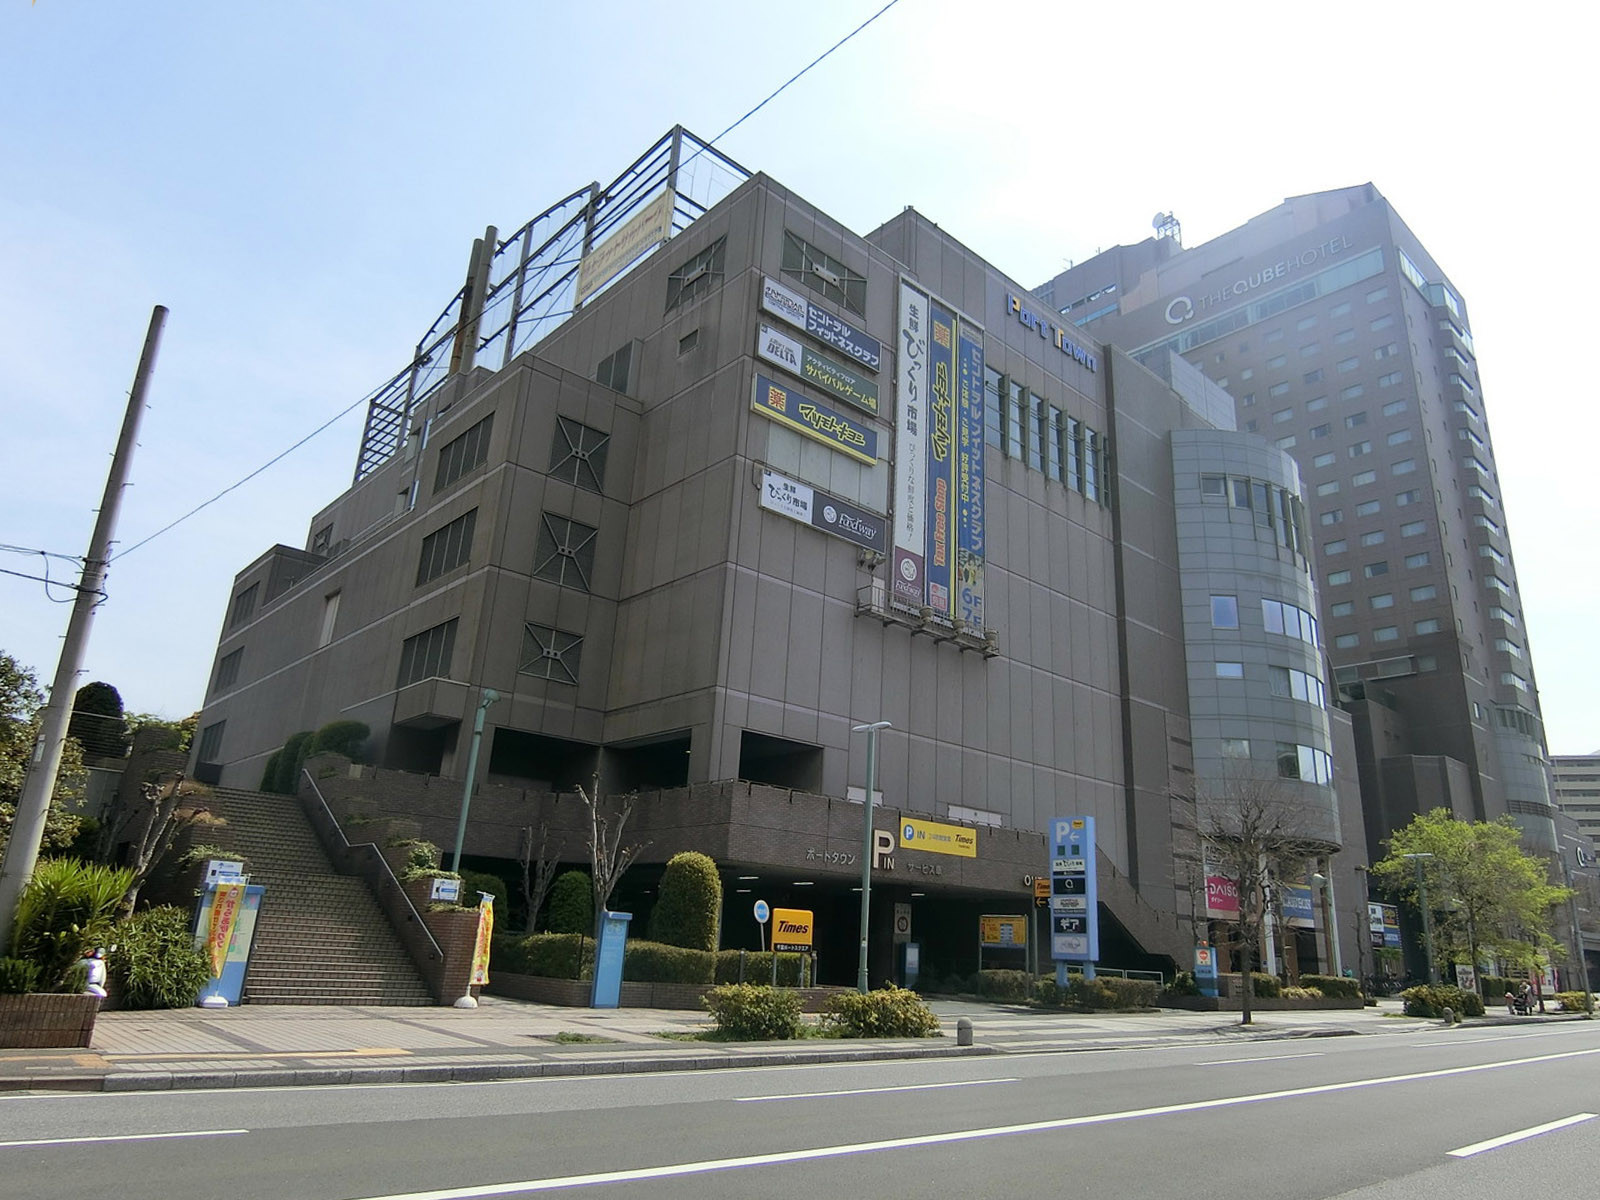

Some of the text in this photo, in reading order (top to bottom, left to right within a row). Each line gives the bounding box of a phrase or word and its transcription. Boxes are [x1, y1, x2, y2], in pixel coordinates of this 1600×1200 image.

[808, 306, 851, 338] セントラル
[1007, 292, 1048, 340] Port
[1051, 323, 1097, 373] Town
[808, 319, 879, 366] フィットネスクラブ
[766, 344, 797, 366] DELTA
[805, 363, 877, 410] サバイバルゲーム場
[770, 387, 786, 411] 薬
[799, 402, 866, 447] マツモトキヨシ
[768, 483, 808, 512] びっくり市場
[935, 477, 947, 513] Shop
[962, 587, 982, 608] 6F
[917, 830, 926, 840] IN
[954, 833, 974, 844] Times
[1056, 821, 1070, 843] P
[806, 847, 856, 866] ポートタウン
[873, 829, 895, 869] P
[883, 857, 895, 870] IN
[1208, 882, 1239, 898] DAISO
[778, 920, 809, 934] Times
[1060, 918, 1080, 930] ギア
